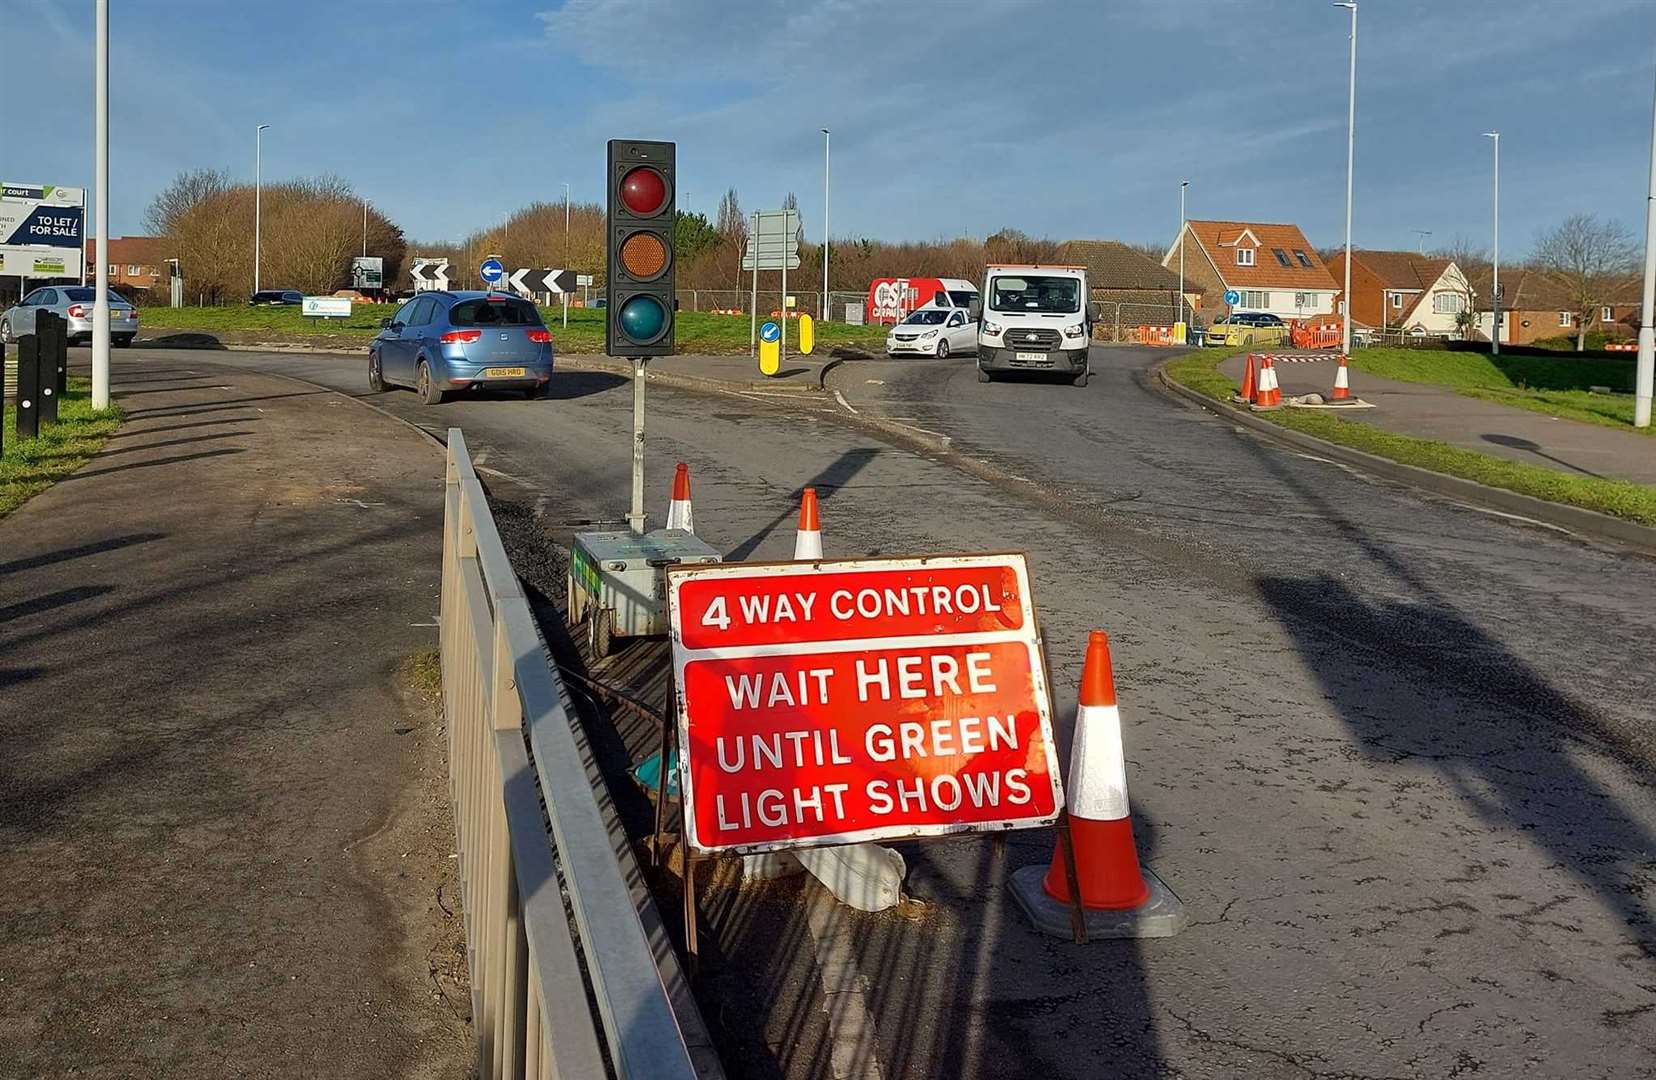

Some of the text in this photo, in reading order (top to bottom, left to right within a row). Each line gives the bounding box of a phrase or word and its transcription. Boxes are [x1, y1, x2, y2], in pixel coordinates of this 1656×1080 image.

[7, 188, 29, 197] court
[30, 225, 77, 236] FOR SALE
[38, 216, 52, 225] TO
[54, 217, 72, 227] LET
[701, 584, 1001, 631] 4 WAY CONTROL
[725, 652, 997, 710] WAIT HERE
[715, 715, 1018, 773] UNTIL GREEN
[716, 768, 1032, 831] LIGHT SHOWS
